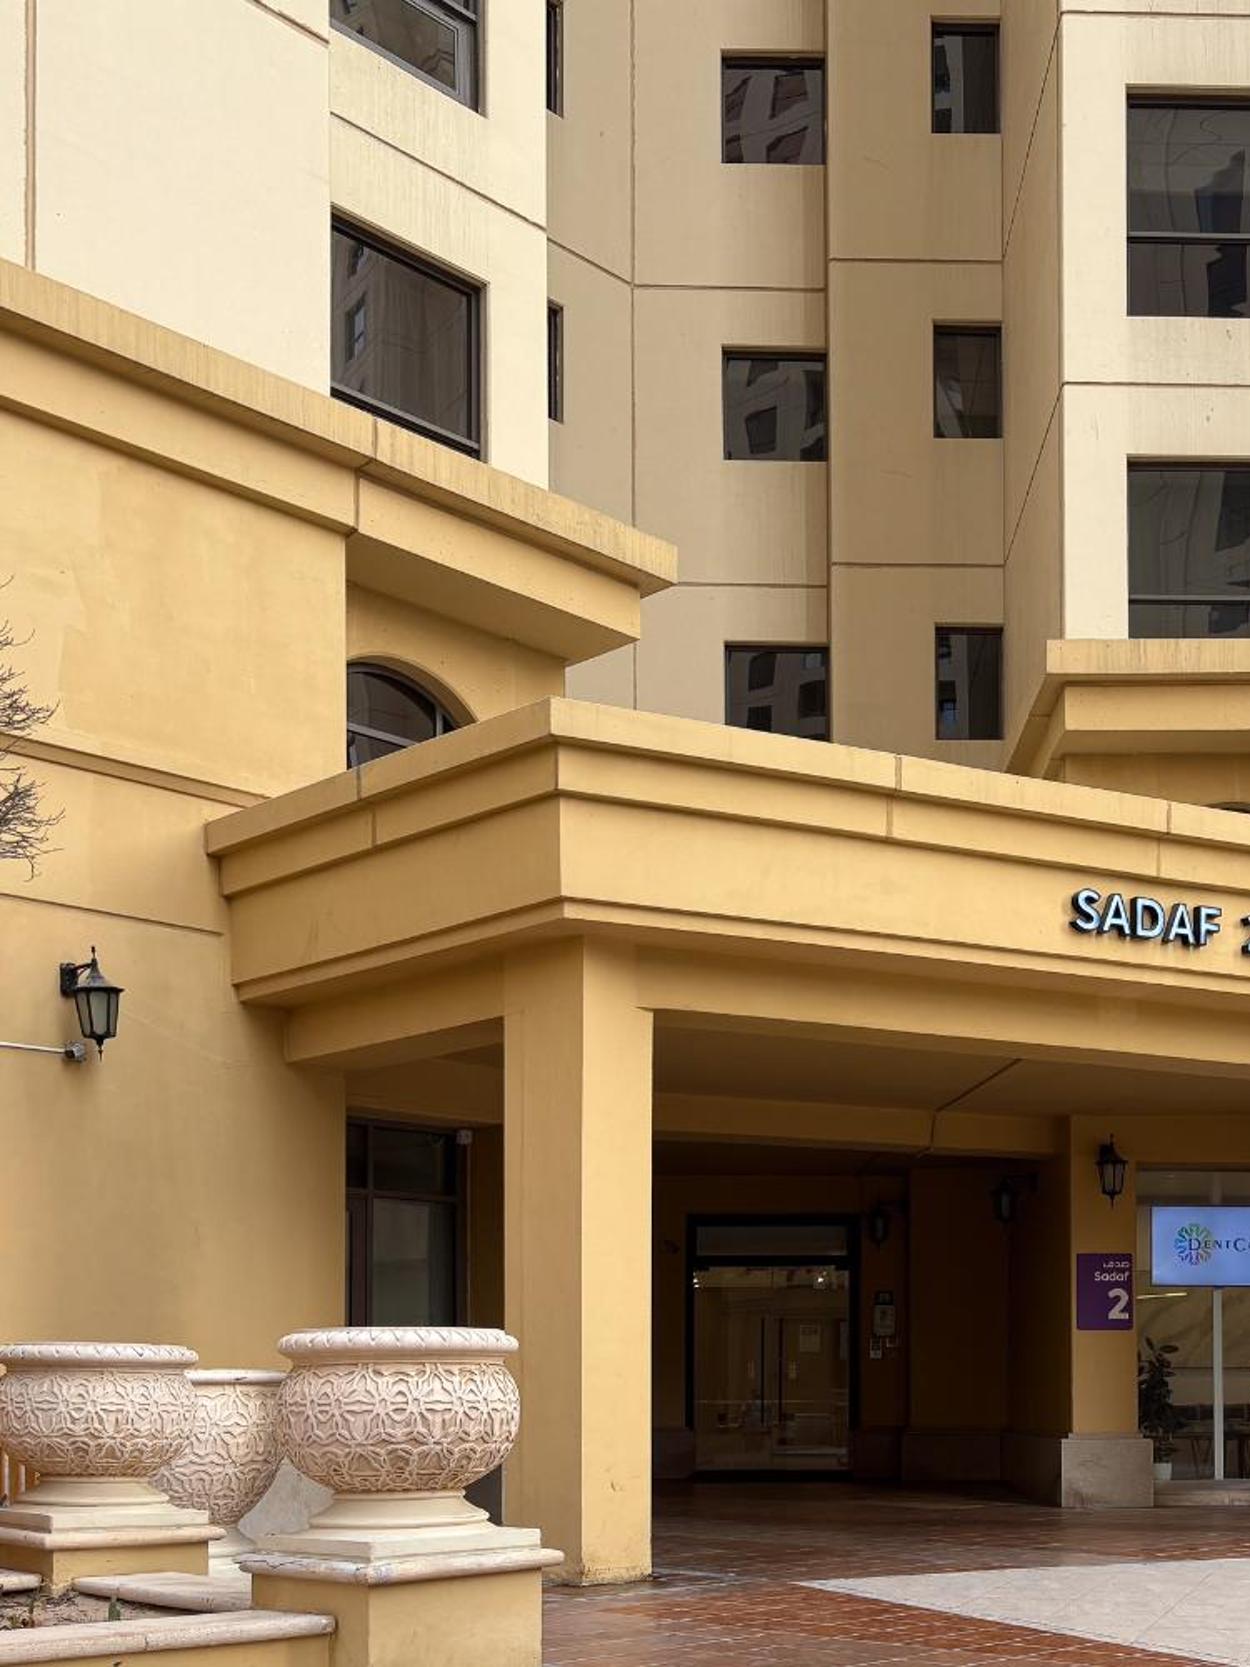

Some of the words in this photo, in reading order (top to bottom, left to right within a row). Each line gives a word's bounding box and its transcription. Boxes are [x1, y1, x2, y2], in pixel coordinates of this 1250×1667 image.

[1070, 888, 1222, 948] SADAF
[1094, 1271, 1130, 1281] Sadaf
[1107, 1288, 1129, 1320] 2
